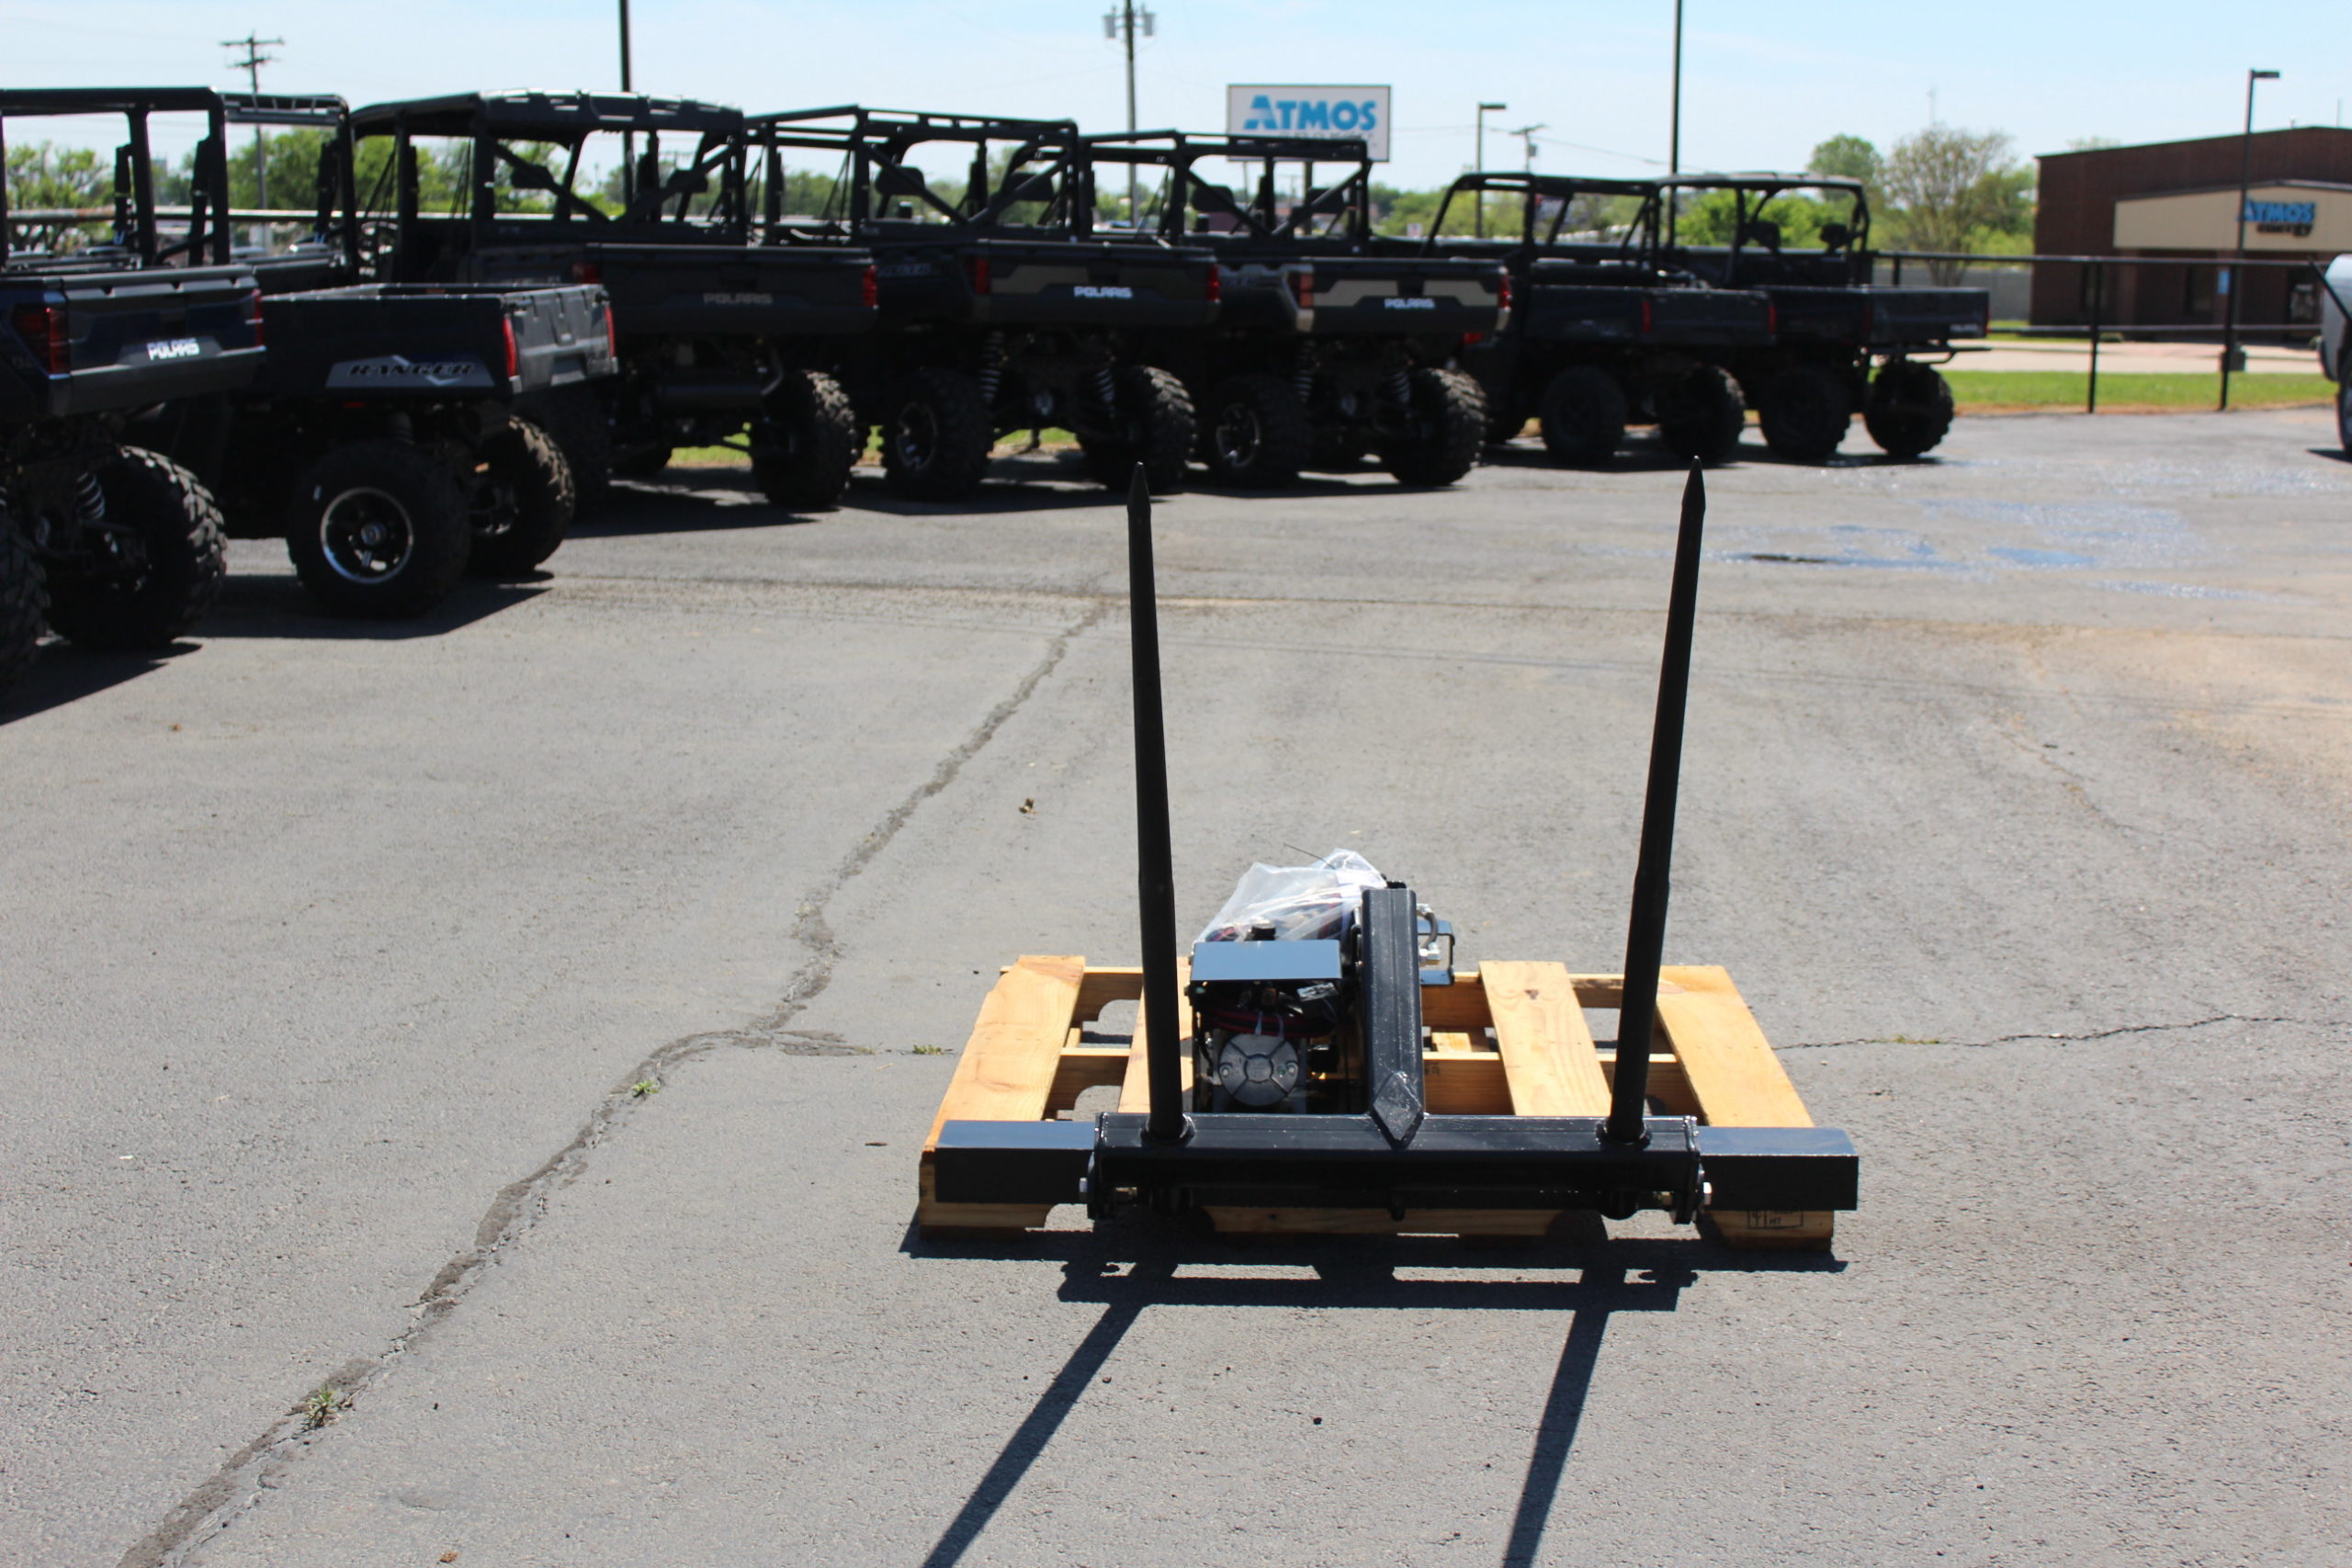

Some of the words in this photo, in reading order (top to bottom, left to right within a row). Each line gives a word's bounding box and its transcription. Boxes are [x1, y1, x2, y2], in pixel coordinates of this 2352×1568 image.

[1243, 95, 1377, 130] ATMOS
[2236, 198, 2315, 222] ATMOS
[703, 292, 774, 305] POLARIS
[1073, 286, 1133, 299] POLARIS
[147, 338, 200, 360] POLARIS
